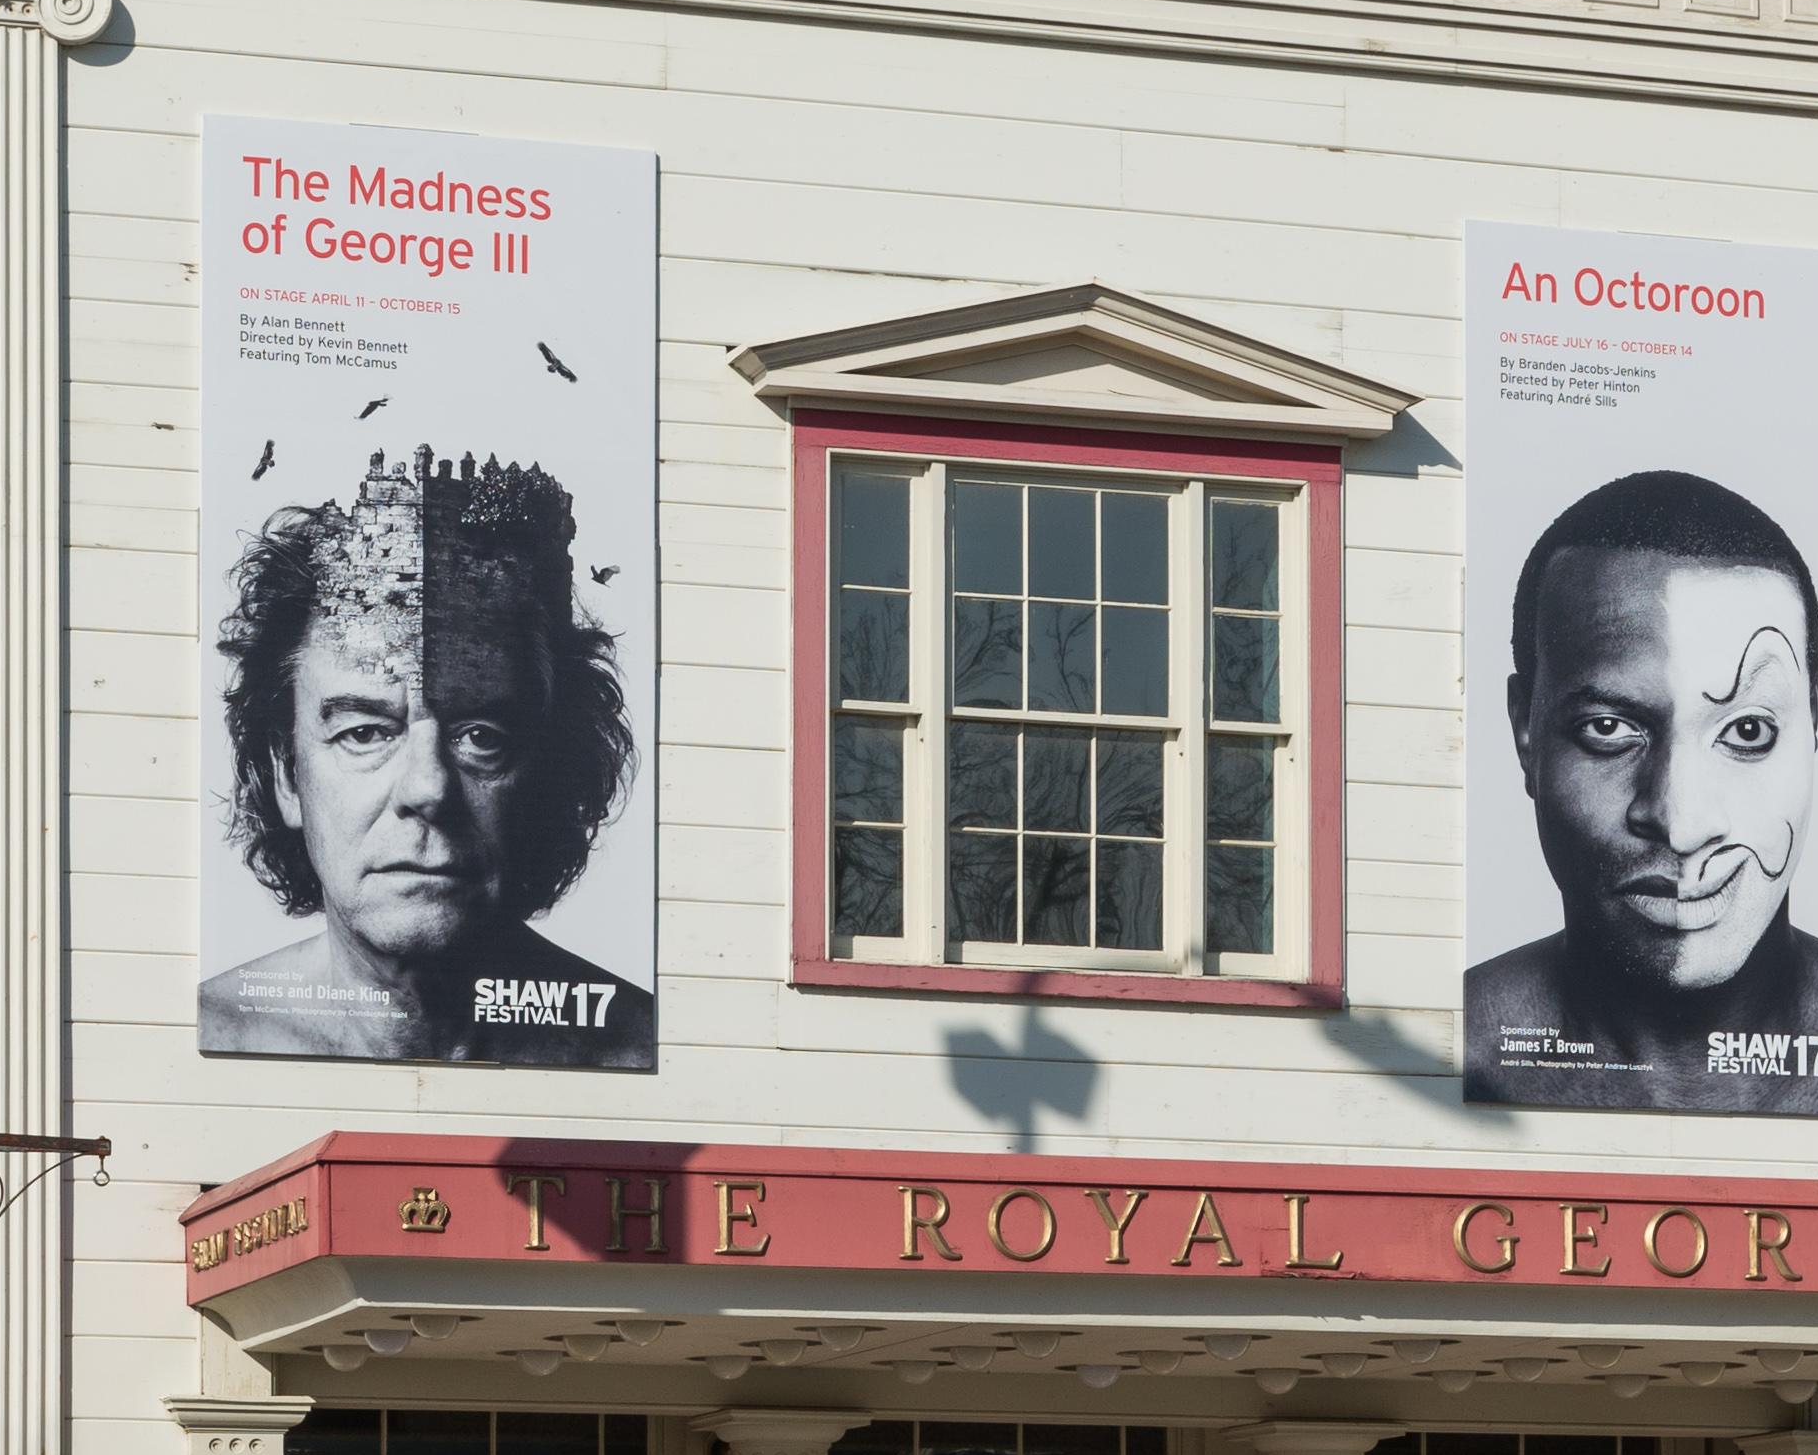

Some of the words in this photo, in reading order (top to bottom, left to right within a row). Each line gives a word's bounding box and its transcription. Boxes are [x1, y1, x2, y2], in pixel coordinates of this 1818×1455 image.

[243, 156, 330, 203] The
[350, 164, 551, 221] Madness
[242, 214, 287, 255] of
[305, 217, 474, 278] George
[493, 232, 529, 274] III
[240, 287, 260, 300] ON
[264, 289, 306, 303] STAGE
[312, 293, 351, 307] APRIL
[356, 296, 365, 307] 11
[379, 298, 443, 313] OCTOBER
[447, 302, 461, 314] 15
[1502, 262, 1557, 303] An
[1574, 267, 1765, 319] Octoroon
[240, 314, 257, 328] By
[261, 316, 290, 328] Alan
[294, 318, 345, 332] Bennett
[240, 331, 294, 346] Directed
[299, 335, 313, 349] by
[318, 337, 353, 350] Kevin
[358, 340, 408, 354] Bennett
[1500, 332, 1517, 344] ON
[1521, 333, 1559, 347] STAGE
[1563, 336, 1593, 349] JULY
[1596, 339, 1609, 350] 16
[1621, 341, 1677, 355] OCTOBER
[1680, 346, 1693, 356] 14
[240, 348, 300, 365] Featuring
[305, 352, 331, 365] Tom
[336, 354, 397, 370] McCamus
[1500, 357, 1515, 371] By
[1519, 359, 1567, 373] Branden
[1570, 361, 1656, 379] Jacobs-Jenkins
[1500, 372, 1548, 387] Directed
[1551, 376, 1565, 390] by
[1569, 378, 1599, 392] Peter
[1603, 380, 1640, 394] Hinton
[1500, 389, 1554, 405] Featuring
[1557, 392, 1592, 406] André
[1595, 395, 1618, 408] Sills
[238, 969, 289, 980] Sponsored
[292, 972, 304, 982] by
[238, 982, 283, 998] James
[288, 985, 312, 999] and
[317, 985, 355, 1000] Diane
[360, 987, 390, 1005] King
[474, 978, 569, 1008] SHAW
[571, 983, 616, 1028] 17
[474, 1005, 569, 1026] FESTIVAL
[1500, 1026, 1546, 1036] Sponsored
[1549, 1027, 1560, 1038] by
[1500, 1038, 1540, 1052] James
[1544, 1039, 1553, 1052] F.
[1557, 1040, 1594, 1054] Brown
[1707, 1031, 1791, 1058] SHAW
[1536, 1061, 1576, 1070] Photography
[1707, 1056, 1791, 1076] FESTIVAL
[506, 1172, 772, 1257] THE
[897, 1184, 1344, 1270] ROYAL
